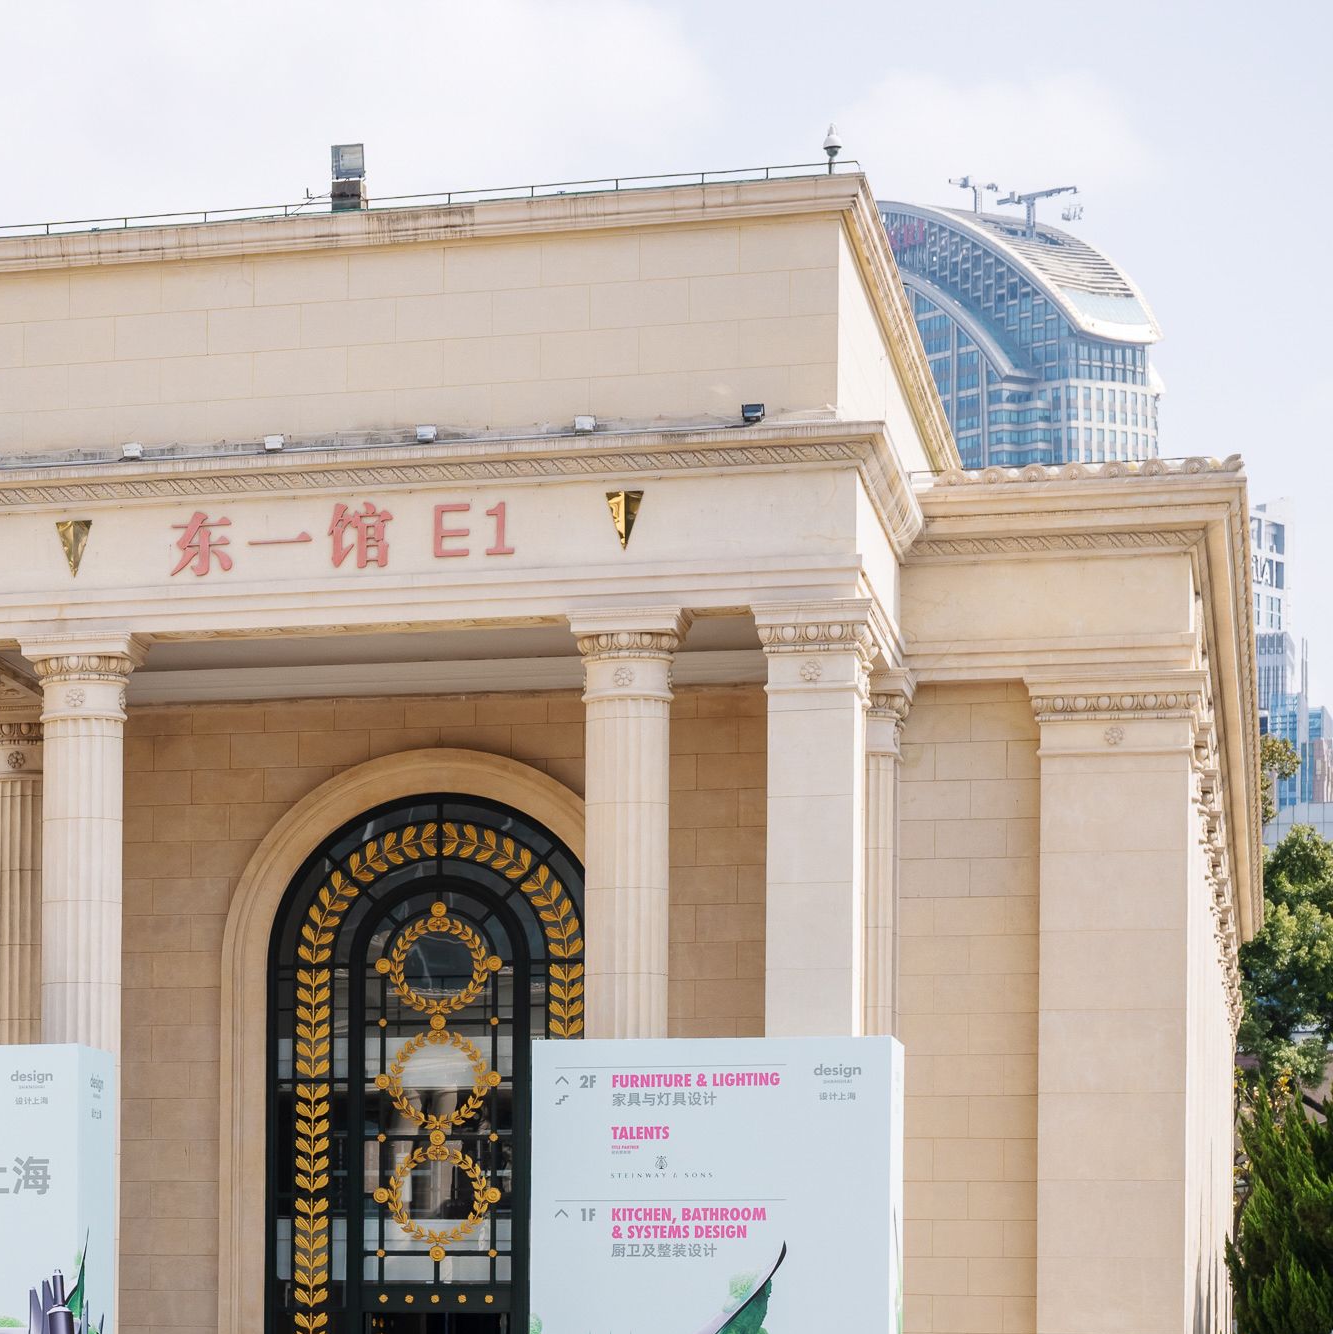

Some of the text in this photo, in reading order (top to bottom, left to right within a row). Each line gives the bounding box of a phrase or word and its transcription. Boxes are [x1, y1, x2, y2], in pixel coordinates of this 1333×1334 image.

[171, 501, 515, 577] 东一馆 E1
[10, 1069, 54, 1084] design
[813, 1063, 862, 1078] design
[579, 1075, 597, 1089] 2F
[611, 1071, 781, 1089] FURNITURE & LIGHTING
[611, 1091, 717, 1107] 家具与灯具设计
[819, 1091, 856, 1100] 设计上海
[611, 1125, 670, 1140] TALENTS
[580, 1208, 596, 1222] 1F
[611, 1207, 767, 1224] KITCHEN, BATHROOM
[611, 1225, 747, 1239] & SYSTEMS DESIGN
[611, 1243, 717, 1258] 厨卫及整装设计
